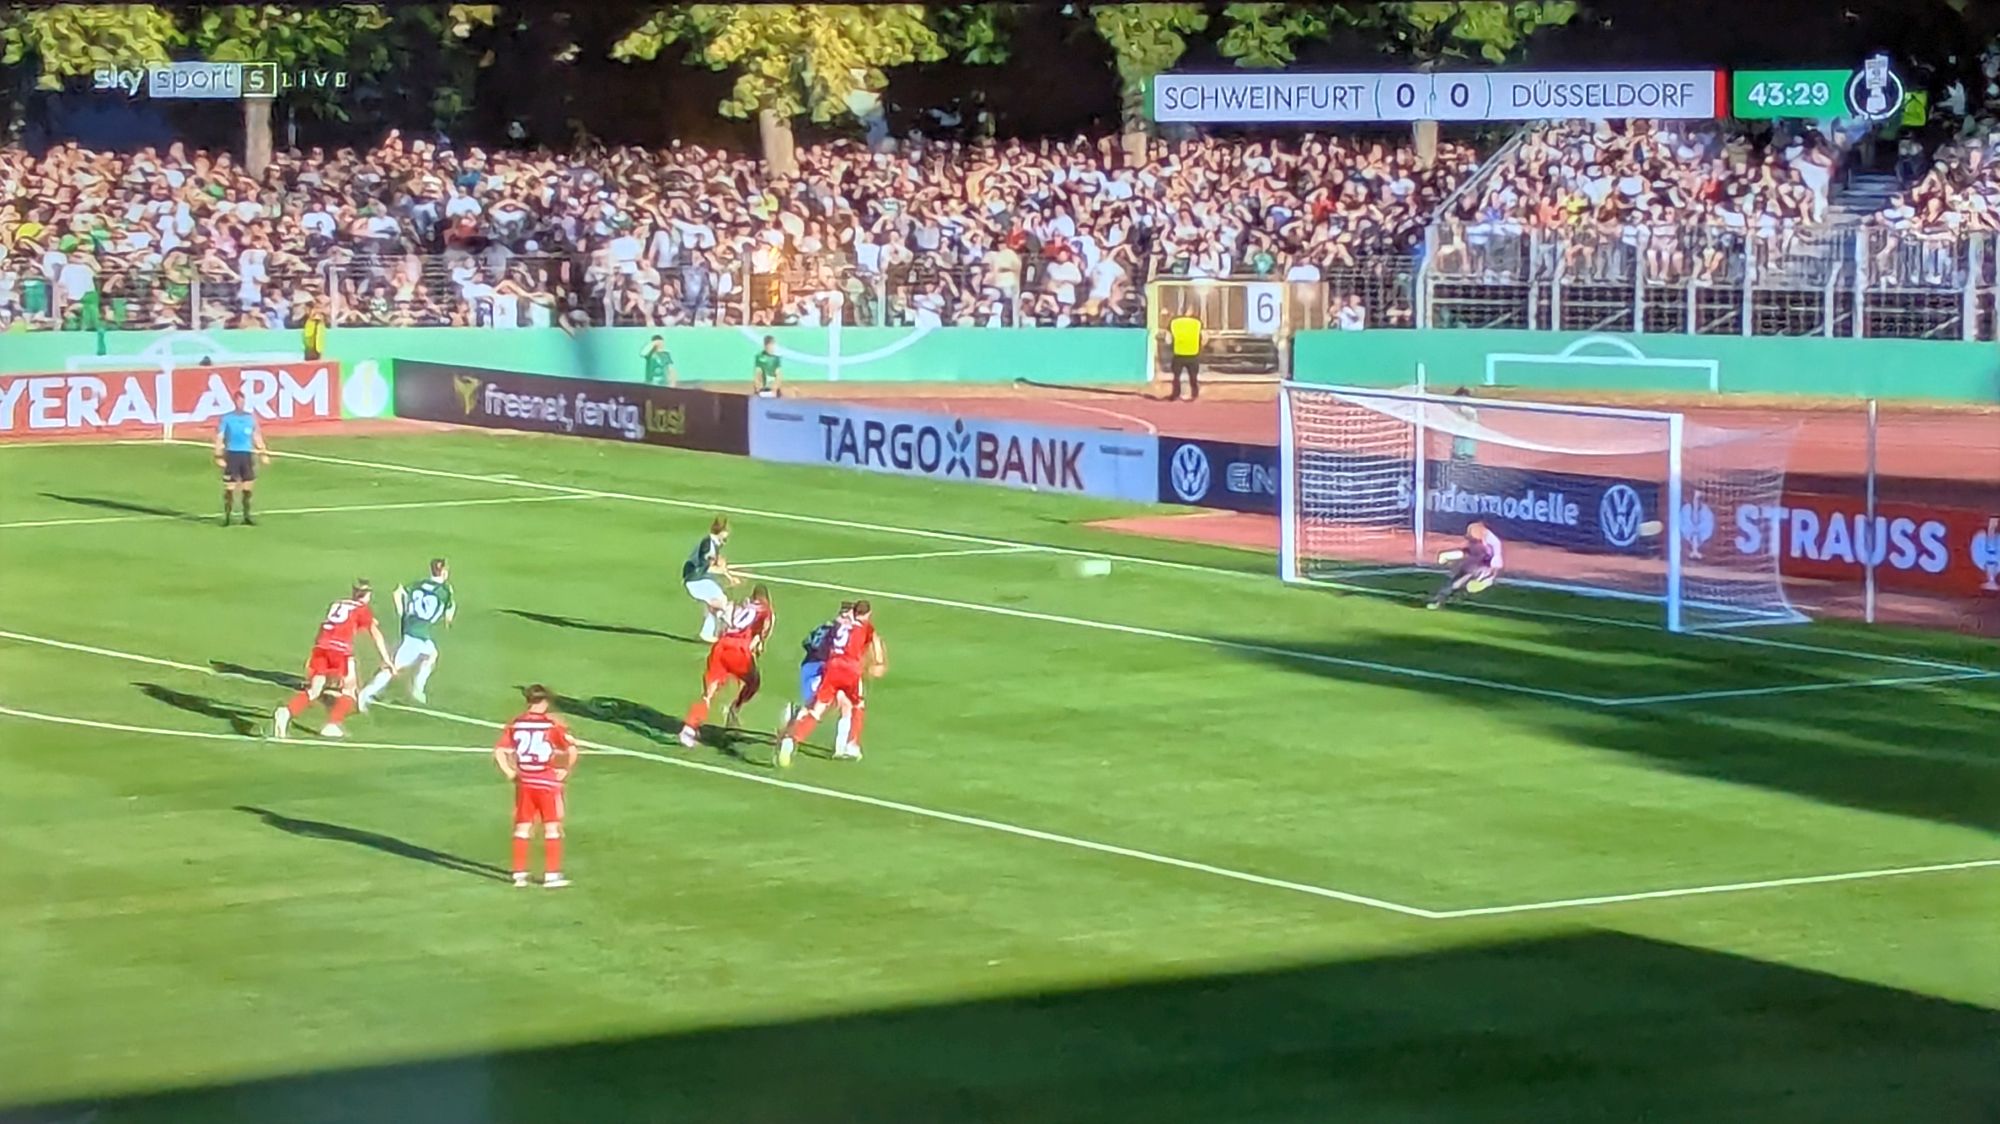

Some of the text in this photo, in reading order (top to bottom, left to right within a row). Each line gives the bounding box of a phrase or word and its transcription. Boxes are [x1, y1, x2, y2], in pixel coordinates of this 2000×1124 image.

[1256, 292, 1274, 323] 6
[1396, 481, 1580, 526] Sndermodelle
[1735, 503, 1948, 573] STRAUSS
